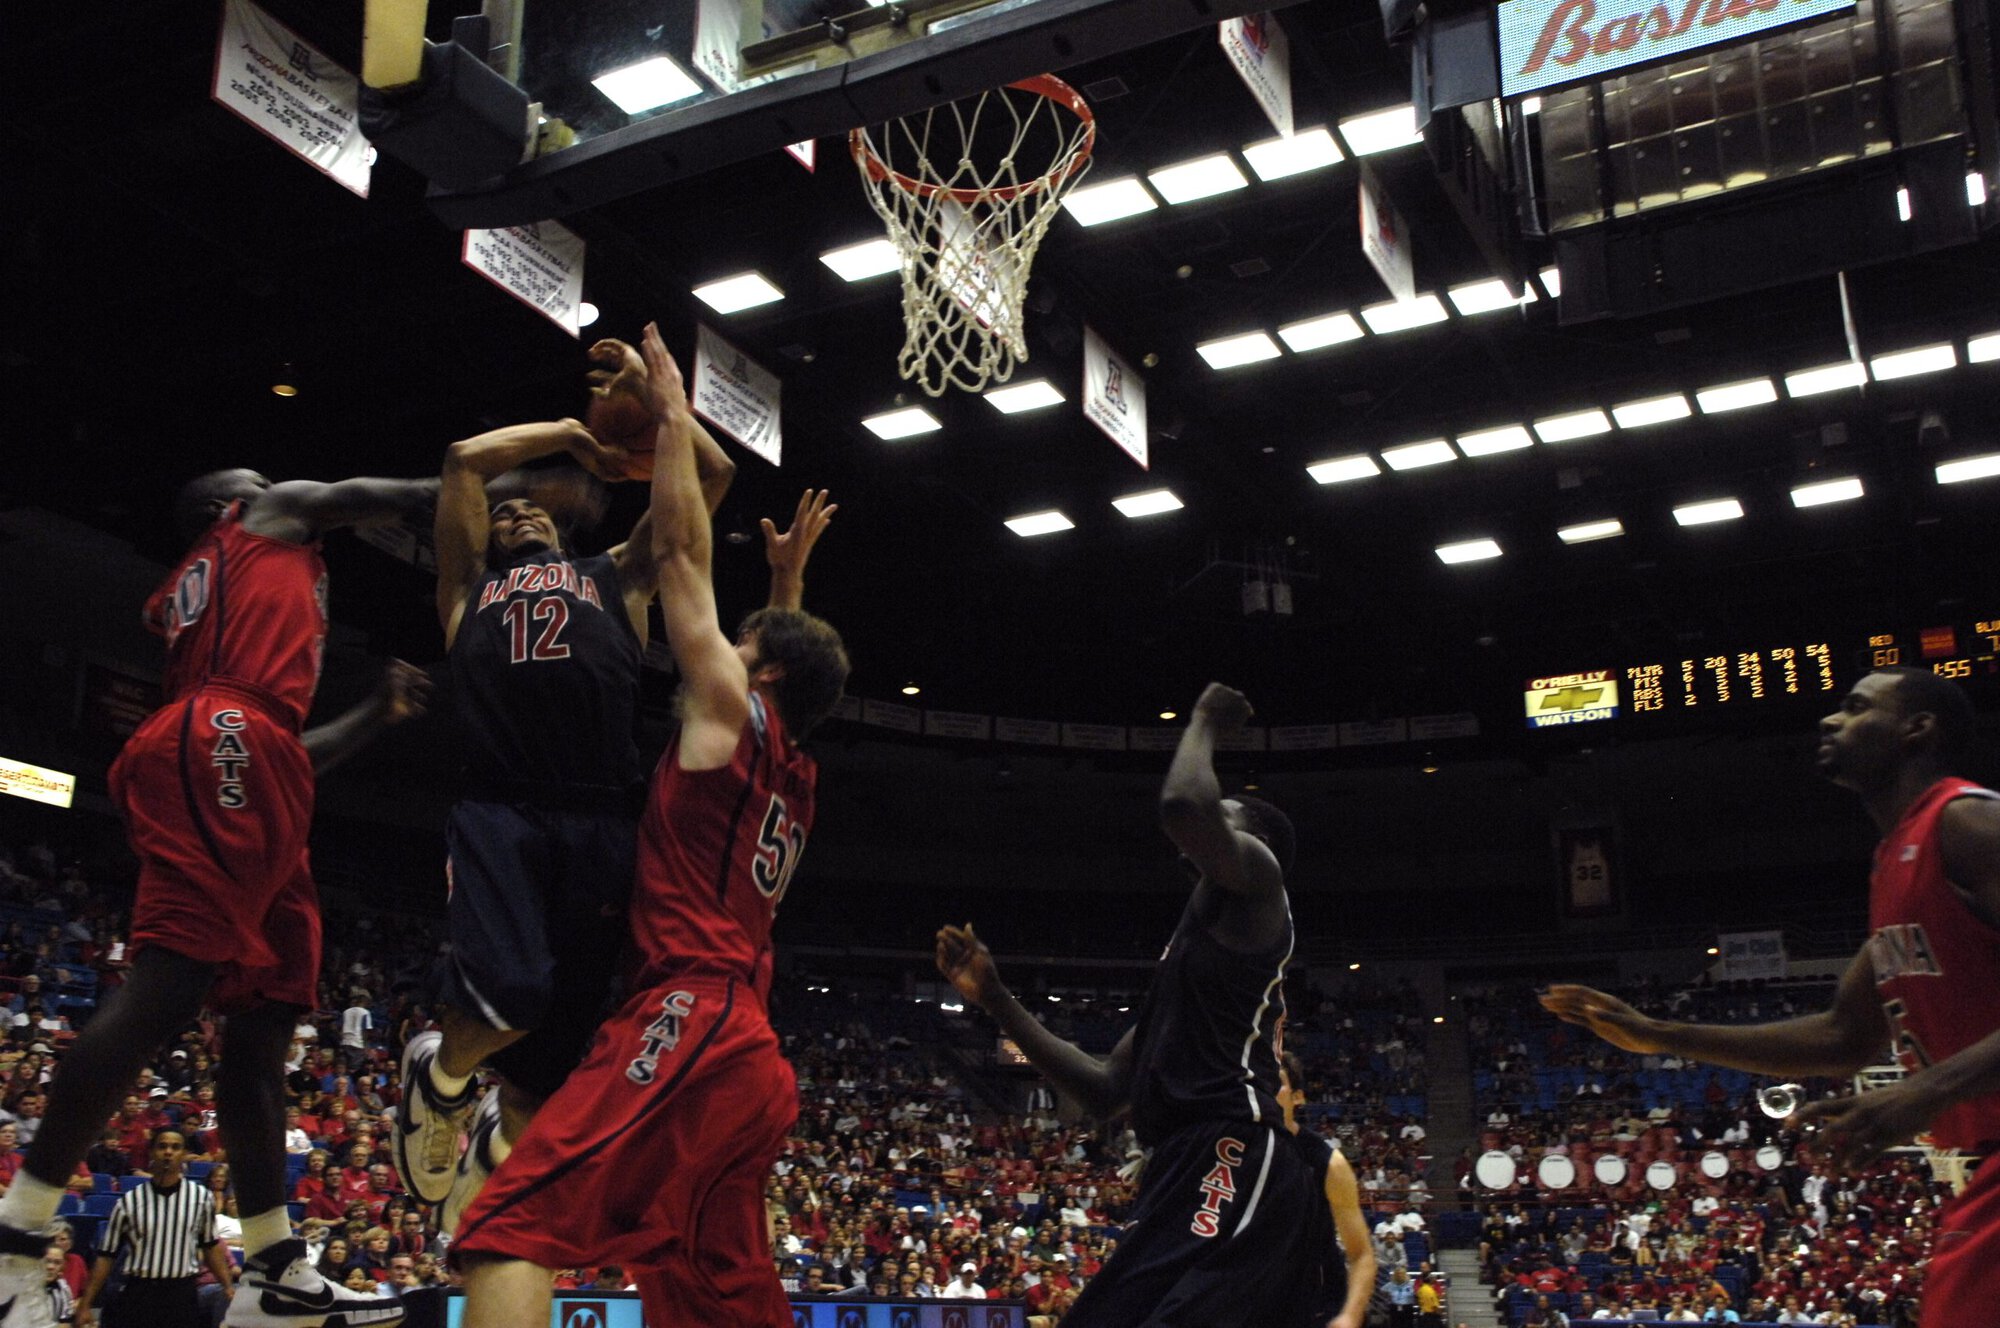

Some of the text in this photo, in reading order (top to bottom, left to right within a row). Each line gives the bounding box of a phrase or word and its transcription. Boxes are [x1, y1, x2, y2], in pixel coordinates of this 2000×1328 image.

[277, 87, 349, 134] TOURNAMENT
[286, 72, 355, 122] BASKETBALL
[476, 560, 604, 614] ARIZONA
[502, 595, 571, 664] 12
[1868, 634, 1894, 648] RED
[1634, 676, 1660, 689] PTS
[1682, 671, 1694, 683] 6
[1783, 659, 1796, 670] 4
[1818, 654, 1831, 667] 5
[1681, 660, 1694, 672] 5
[1704, 655, 1727, 669] 20
[1737, 652, 1760, 665] 34
[1771, 647, 1795, 661] 50
[1805, 643, 1830, 657] 54
[1873, 648, 1899, 667] 60
[1531, 671, 1607, 690] O'RIELLY
[1750, 675, 1763, 687] 2
[1784, 670, 1798, 683] 2
[1819, 666, 1832, 677] 4
[1634, 698, 1664, 712] FLS
[1684, 694, 1697, 706] 2
[1752, 686, 1765, 698] 2
[1786, 682, 1799, 693] 4
[1820, 678, 1834, 690] 3
[1534, 708, 1613, 727] WATSON
[210, 709, 250, 809] CATS
[1576, 865, 1602, 881] 32
[625, 990, 695, 1085] CATS
[1190, 1137, 1246, 1237] CATS
